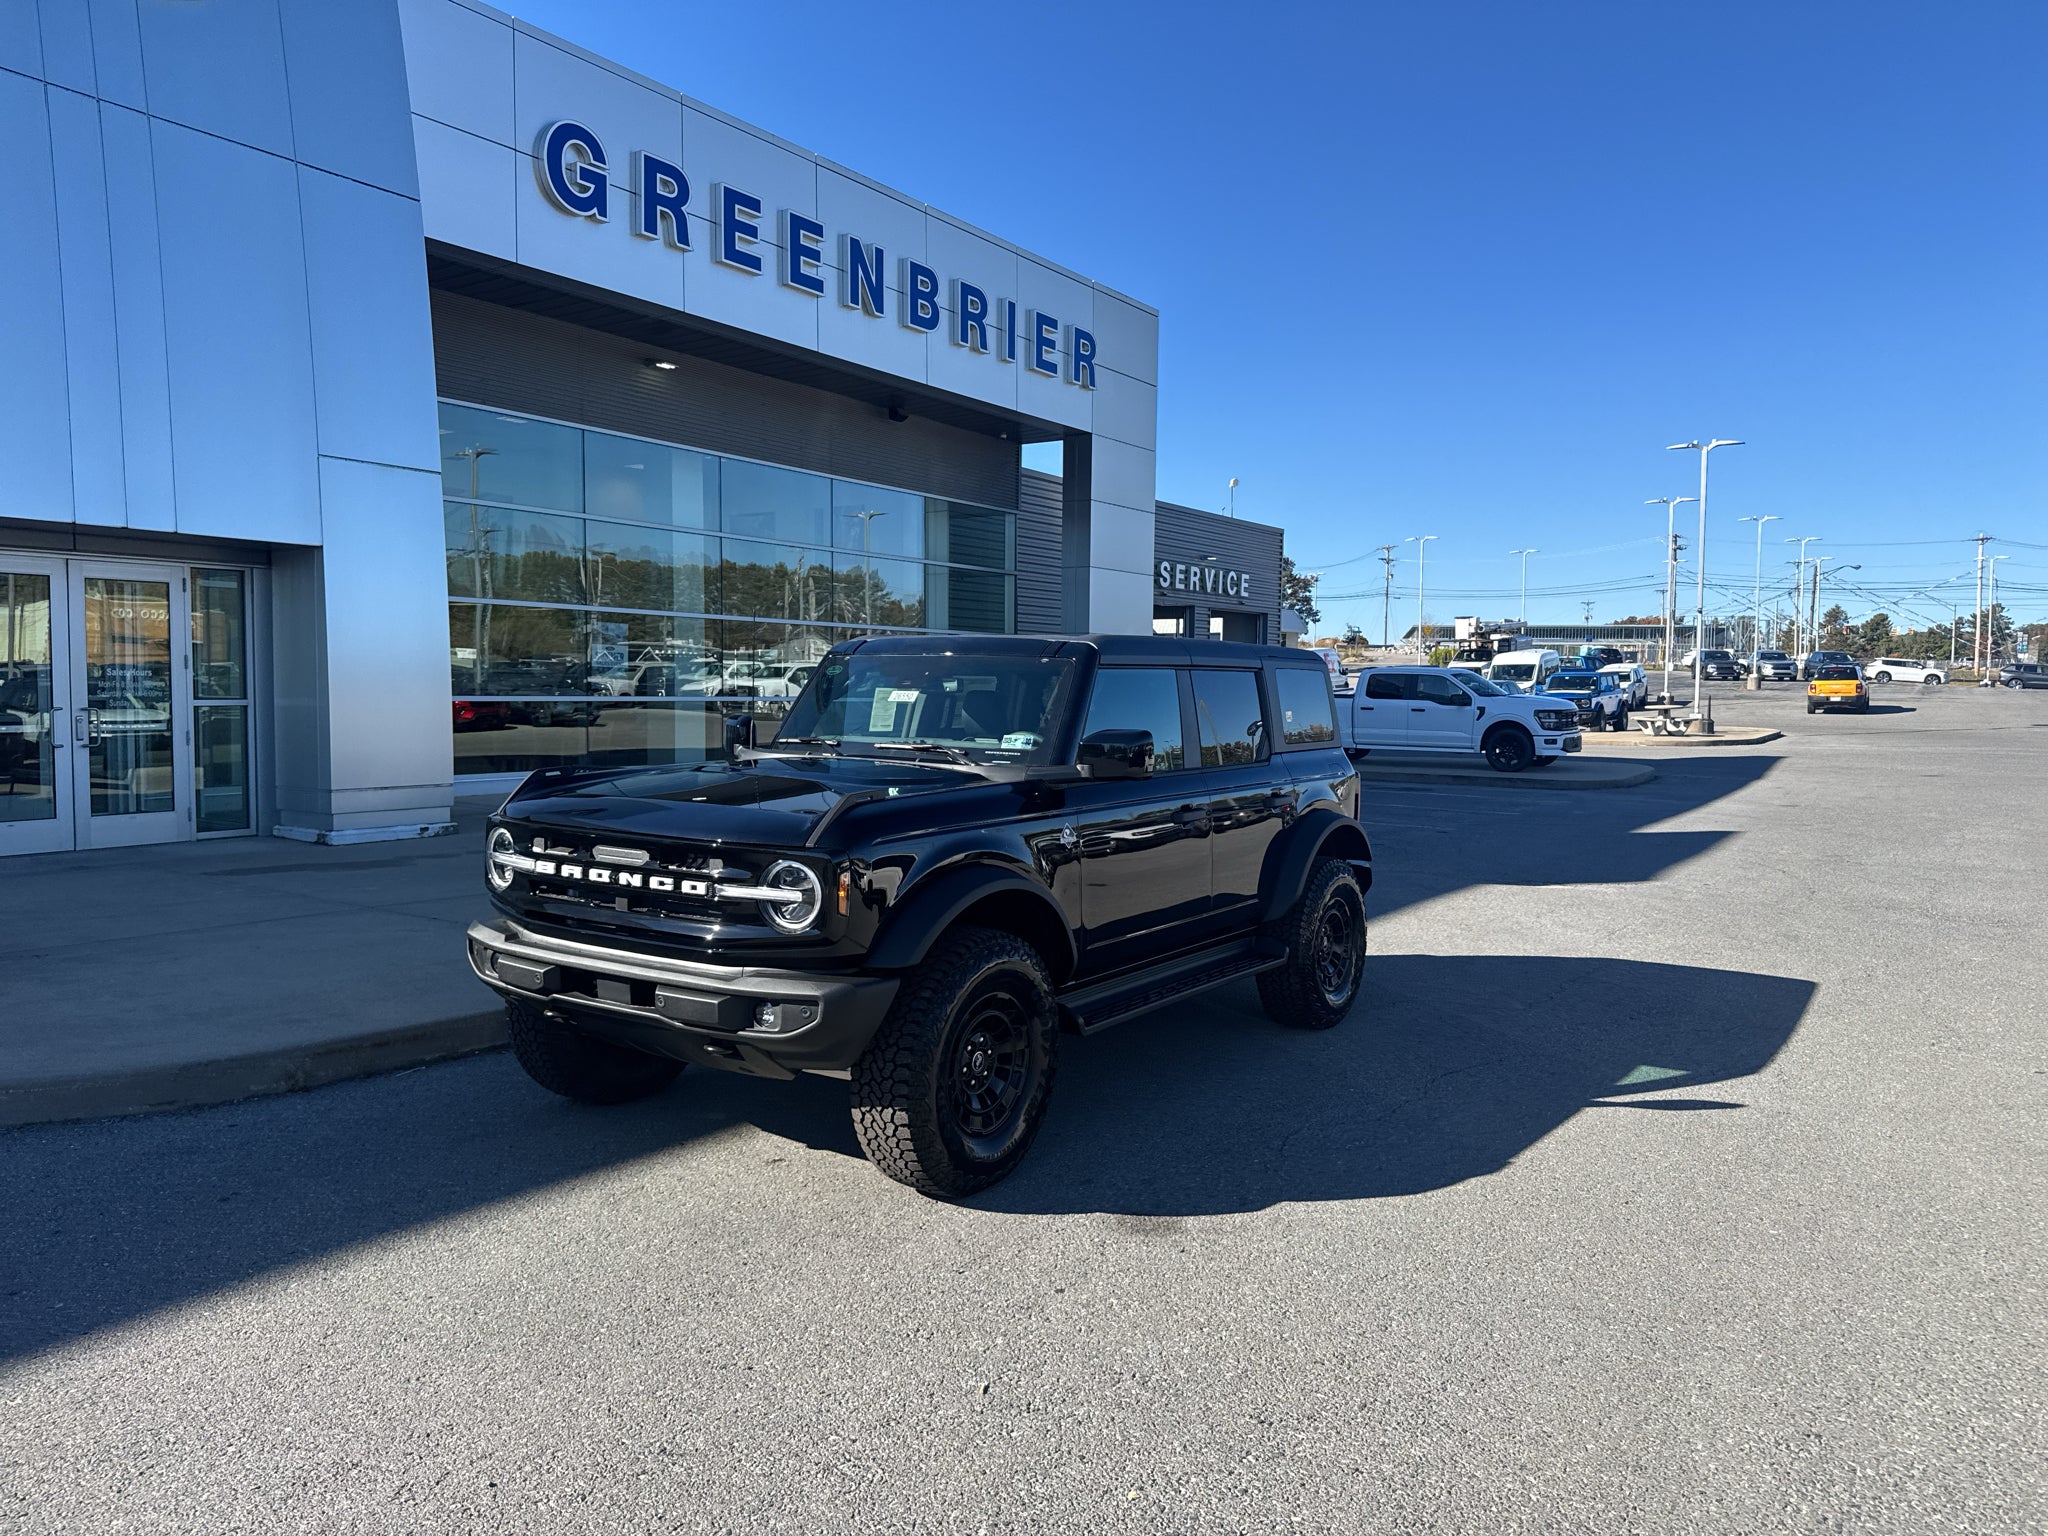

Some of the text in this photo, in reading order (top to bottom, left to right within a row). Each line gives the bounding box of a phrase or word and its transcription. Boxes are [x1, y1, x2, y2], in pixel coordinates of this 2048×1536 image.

[535, 119, 1097, 391] GREENBRIER
[1159, 561, 1251, 598] SERVICE
[106, 668, 152, 677] Sales Hours
[535, 859, 708, 896] BRONCO
